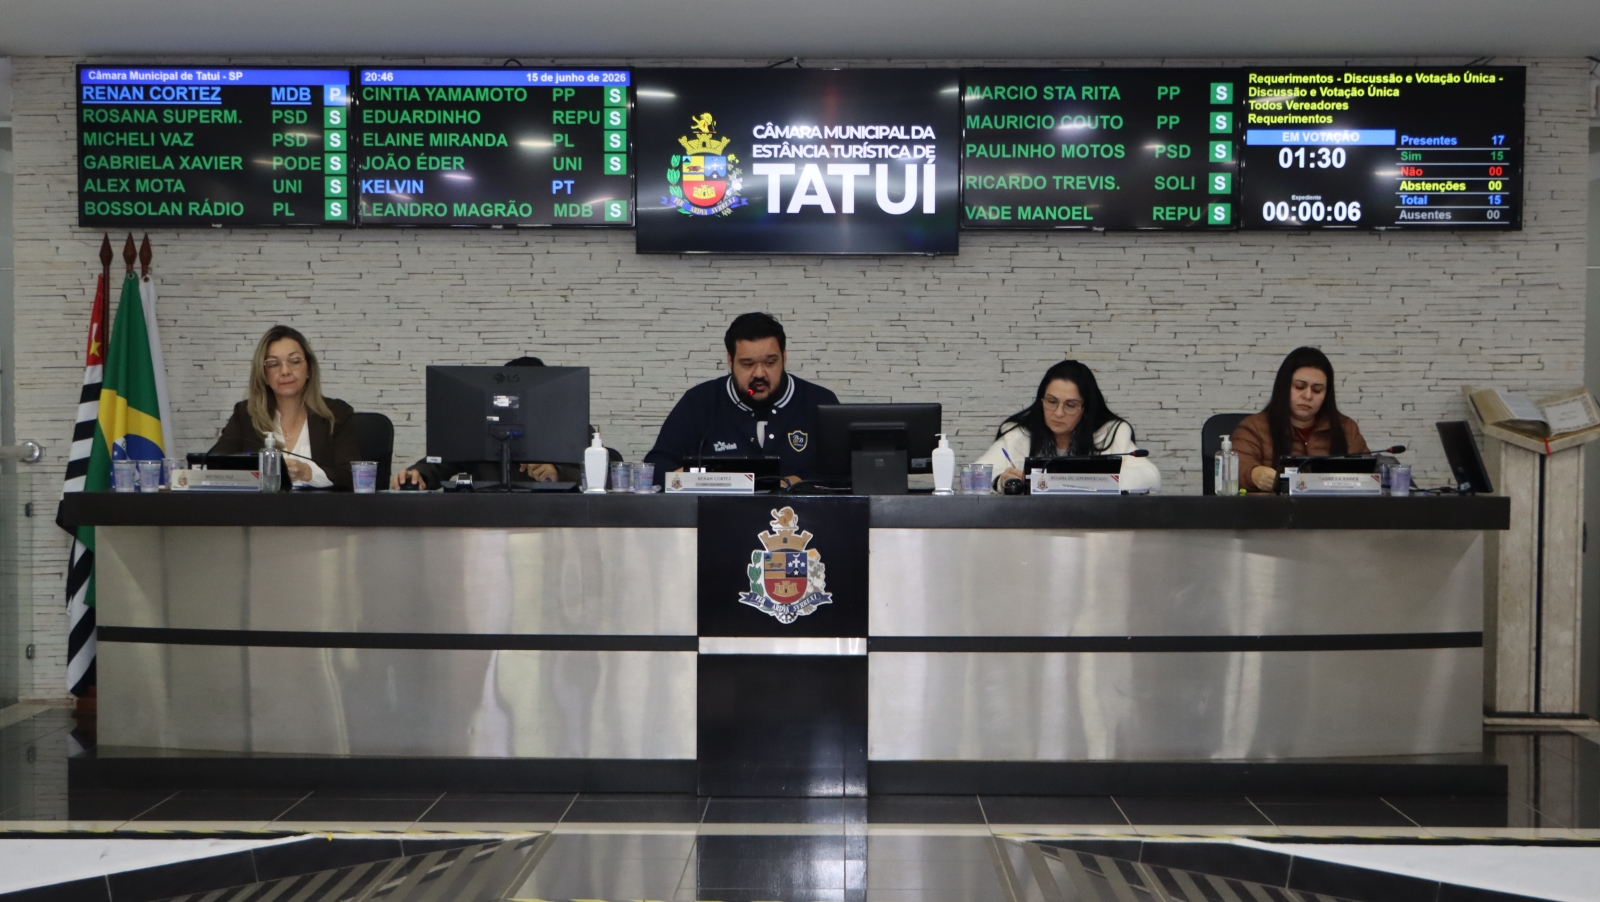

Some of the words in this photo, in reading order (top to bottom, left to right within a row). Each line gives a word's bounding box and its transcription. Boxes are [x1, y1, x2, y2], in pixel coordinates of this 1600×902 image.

[88, 71, 127, 80] Câmara
[130, 71, 178, 82] Municipal
[181, 72, 193, 80] de
[229, 72, 243, 81] SP
[364, 72, 394, 82] 20:46
[527, 73, 538, 82] 15
[541, 73, 553, 83] de
[555, 73, 585, 84] junho
[587, 74, 599, 83] de
[602, 73, 626, 83] 2026
[1249, 73, 1333, 86] Requerimentos
[1344, 73, 1403, 84] Discussão
[1405, 76, 1413, 84] e
[1415, 73, 1460, 86] Votação
[1463, 71, 1496, 84] Única
[82, 86, 144, 101] RENAN
[150, 86, 222, 101] CORTEZ
[271, 87, 311, 101] MDB
[329, 88, 341, 102] P
[362, 87, 421, 102] CINTIA
[425, 88, 528, 102] YAMAMOTO
[552, 88, 575, 102] PP
[609, 89, 621, 103] S
[966, 86, 1038, 100] MARCIO
[1043, 86, 1077, 100] STA
[1081, 86, 1121, 100] RITA
[1158, 87, 1181, 100] PP
[1216, 86, 1228, 100] S
[1249, 86, 1307, 98] Discussão
[1309, 89, 1317, 98] e
[1319, 87, 1365, 100] Votação
[1368, 85, 1400, 98] Única
[1249, 100, 1283, 111] Todos
[1285, 100, 1349, 111] Vereadores
[83, 109, 158, 123] ROSANA
[163, 109, 243, 124] SUPERM.
[272, 110, 307, 124] PSD
[329, 110, 341, 125] S
[363, 110, 481, 124] EDUARDINHO
[552, 110, 600, 125] REPU
[609, 111, 621, 125] S
[966, 115, 1055, 130] MAURICIO
[1061, 115, 1124, 130] COUTO
[1157, 116, 1180, 129] PP
[1216, 115, 1227, 130] S
[1248, 113, 1333, 126] Requerimentos
[753, 122, 822, 140] CÂMARA
[824, 125, 910, 140] MUNICIPAL
[911, 126, 935, 140] DA
[1282, 132, 1300, 142] EM
[1302, 131, 1360, 144] VOTAÇÃO
[83, 132, 155, 146] MICHELI
[160, 132, 194, 146] VAZ
[272, 133, 308, 147] PSD
[329, 133, 341, 147] S
[363, 133, 424, 147] ELAINE
[429, 133, 508, 147] MIRANDA
[552, 133, 574, 147] PL
[609, 133, 621, 148] S
[1401, 136, 1457, 146] Presentes
[1491, 135, 1505, 146] 17
[752, 141, 830, 159] ESTÂNCIA
[831, 142, 912, 159] TURÍSTICA
[913, 145, 935, 159] DE
[966, 144, 1055, 159] PAULINHO
[1062, 144, 1125, 159] MOTOS
[1155, 144, 1191, 159] PSD
[1215, 144, 1227, 158] S
[1400, 152, 1422, 161] Sim
[1491, 152, 1504, 160] 15
[84, 155, 175, 170] GABRIELA
[179, 156, 243, 170] XAVIER
[272, 156, 322, 170] PODE
[330, 156, 341, 170] S
[362, 153, 411, 171] JOÃO
[417, 153, 465, 170] ÉDER
[553, 157, 582, 171] UNI
[609, 157, 621, 171] S
[1279, 148, 1346, 168] 01:30
[1401, 167, 1423, 176] Não
[1489, 167, 1502, 176] 00
[84, 178, 130, 193] ALEX
[136, 178, 186, 193] MOTA
[273, 180, 302, 193] UNI
[330, 179, 341, 194] S
[362, 180, 424, 194] KELVIN
[552, 180, 574, 194] PT
[753, 158, 936, 215] TATUÍ
[965, 176, 1046, 190] RICARDO
[1052, 176, 1120, 190] TREVIS.
[1154, 176, 1195, 190] SOLI
[1214, 176, 1226, 190] S
[1400, 181, 1466, 193] Abstenções
[1488, 181, 1502, 191] 00
[84, 201, 183, 216] BOSSOLAN
[188, 199, 244, 216] RÁDIO
[273, 203, 295, 216] PL
[330, 202, 341, 217] S
[1400, 196, 1428, 205] Total
[1488, 196, 1501, 204] 15
[361, 203, 447, 217] LEANDRO
[453, 200, 533, 217] MAGRÃO
[554, 203, 593, 217] MDB
[610, 203, 621, 217] S
[964, 206, 1012, 220] VADE
[1018, 206, 1093, 220] MANOEL
[1153, 206, 1201, 220] REPU
[1214, 206, 1226, 221] S
[1262, 202, 1362, 221] 00:00:06
[1400, 210, 1452, 220] Ausentes
[1487, 210, 1500, 220] 00
[755, 595, 766, 604] PER
